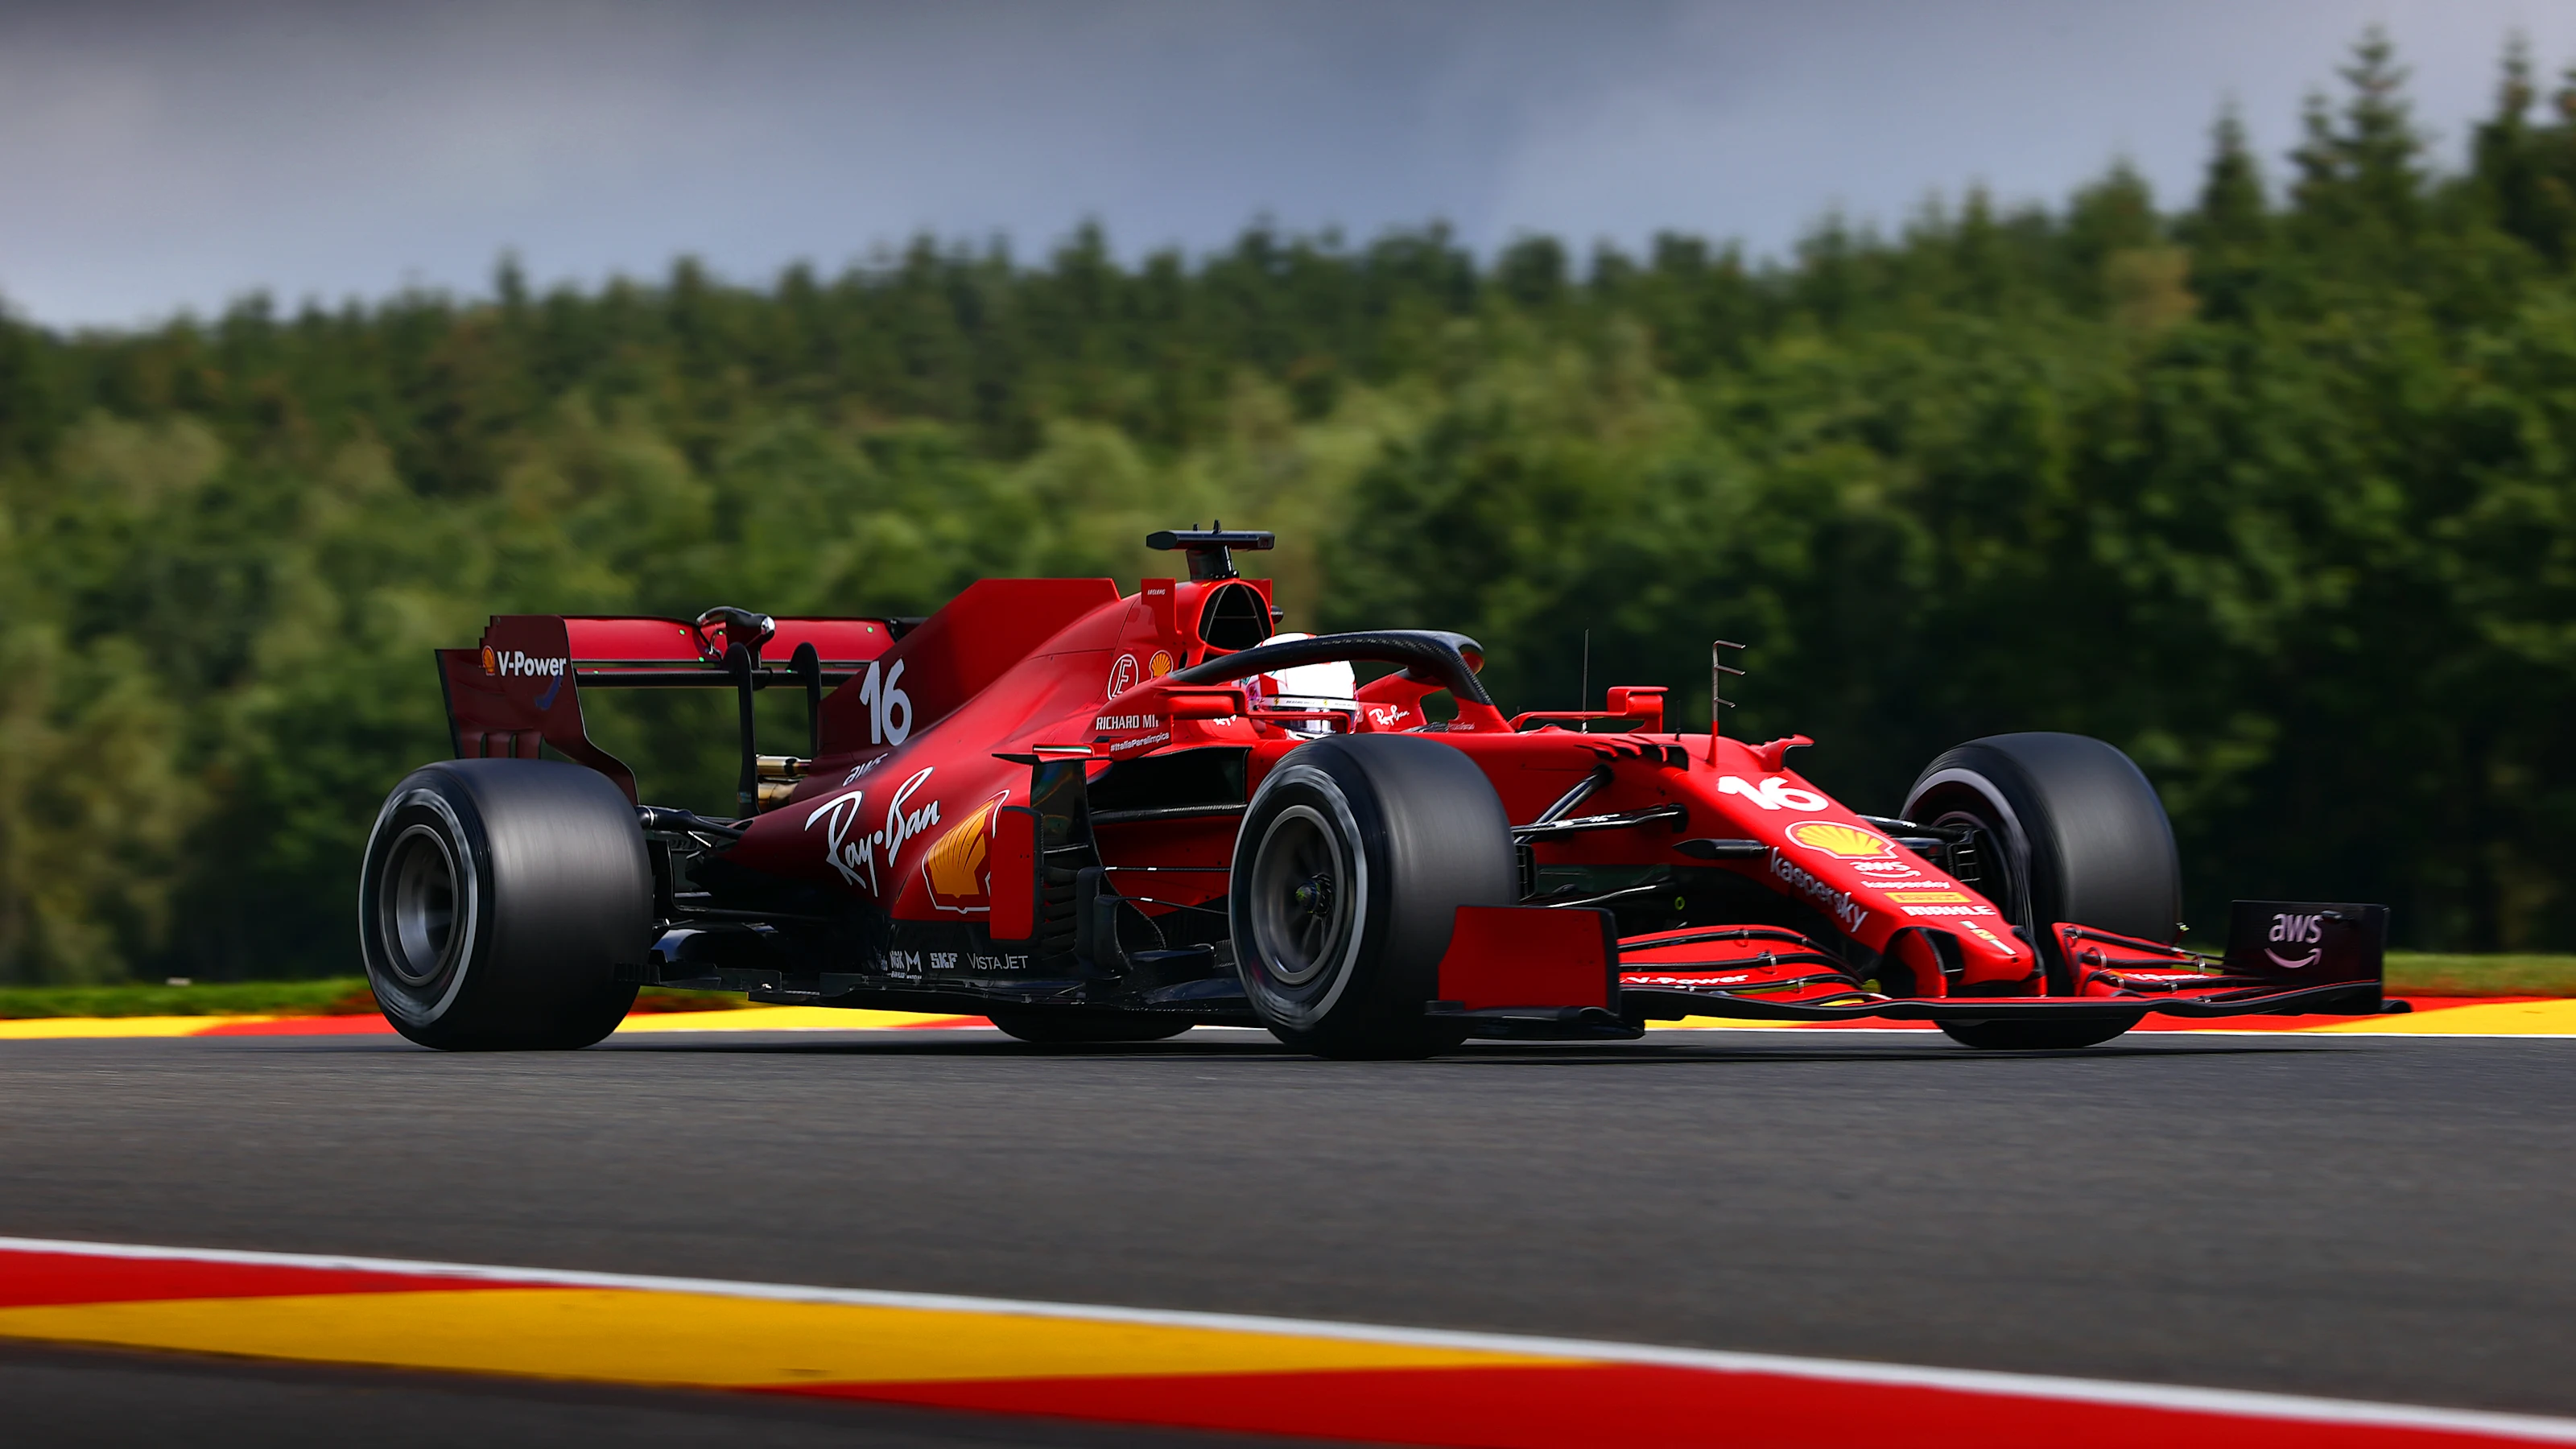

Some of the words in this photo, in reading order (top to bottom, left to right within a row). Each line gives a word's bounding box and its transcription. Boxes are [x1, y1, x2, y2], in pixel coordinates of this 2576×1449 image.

[497, 650, 567, 676] V-Power
[859, 658, 912, 746] 16
[1096, 715, 1140, 731] RICHARD
[1110, 732, 1170, 753] #ItaliaParalimpica
[1717, 774, 1830, 812] 16
[1770, 846, 1868, 932] kaspersky
[1901, 905, 1996, 916] MAHLE
[2268, 913, 2323, 943] aws
[930, 952, 958, 969] SKF
